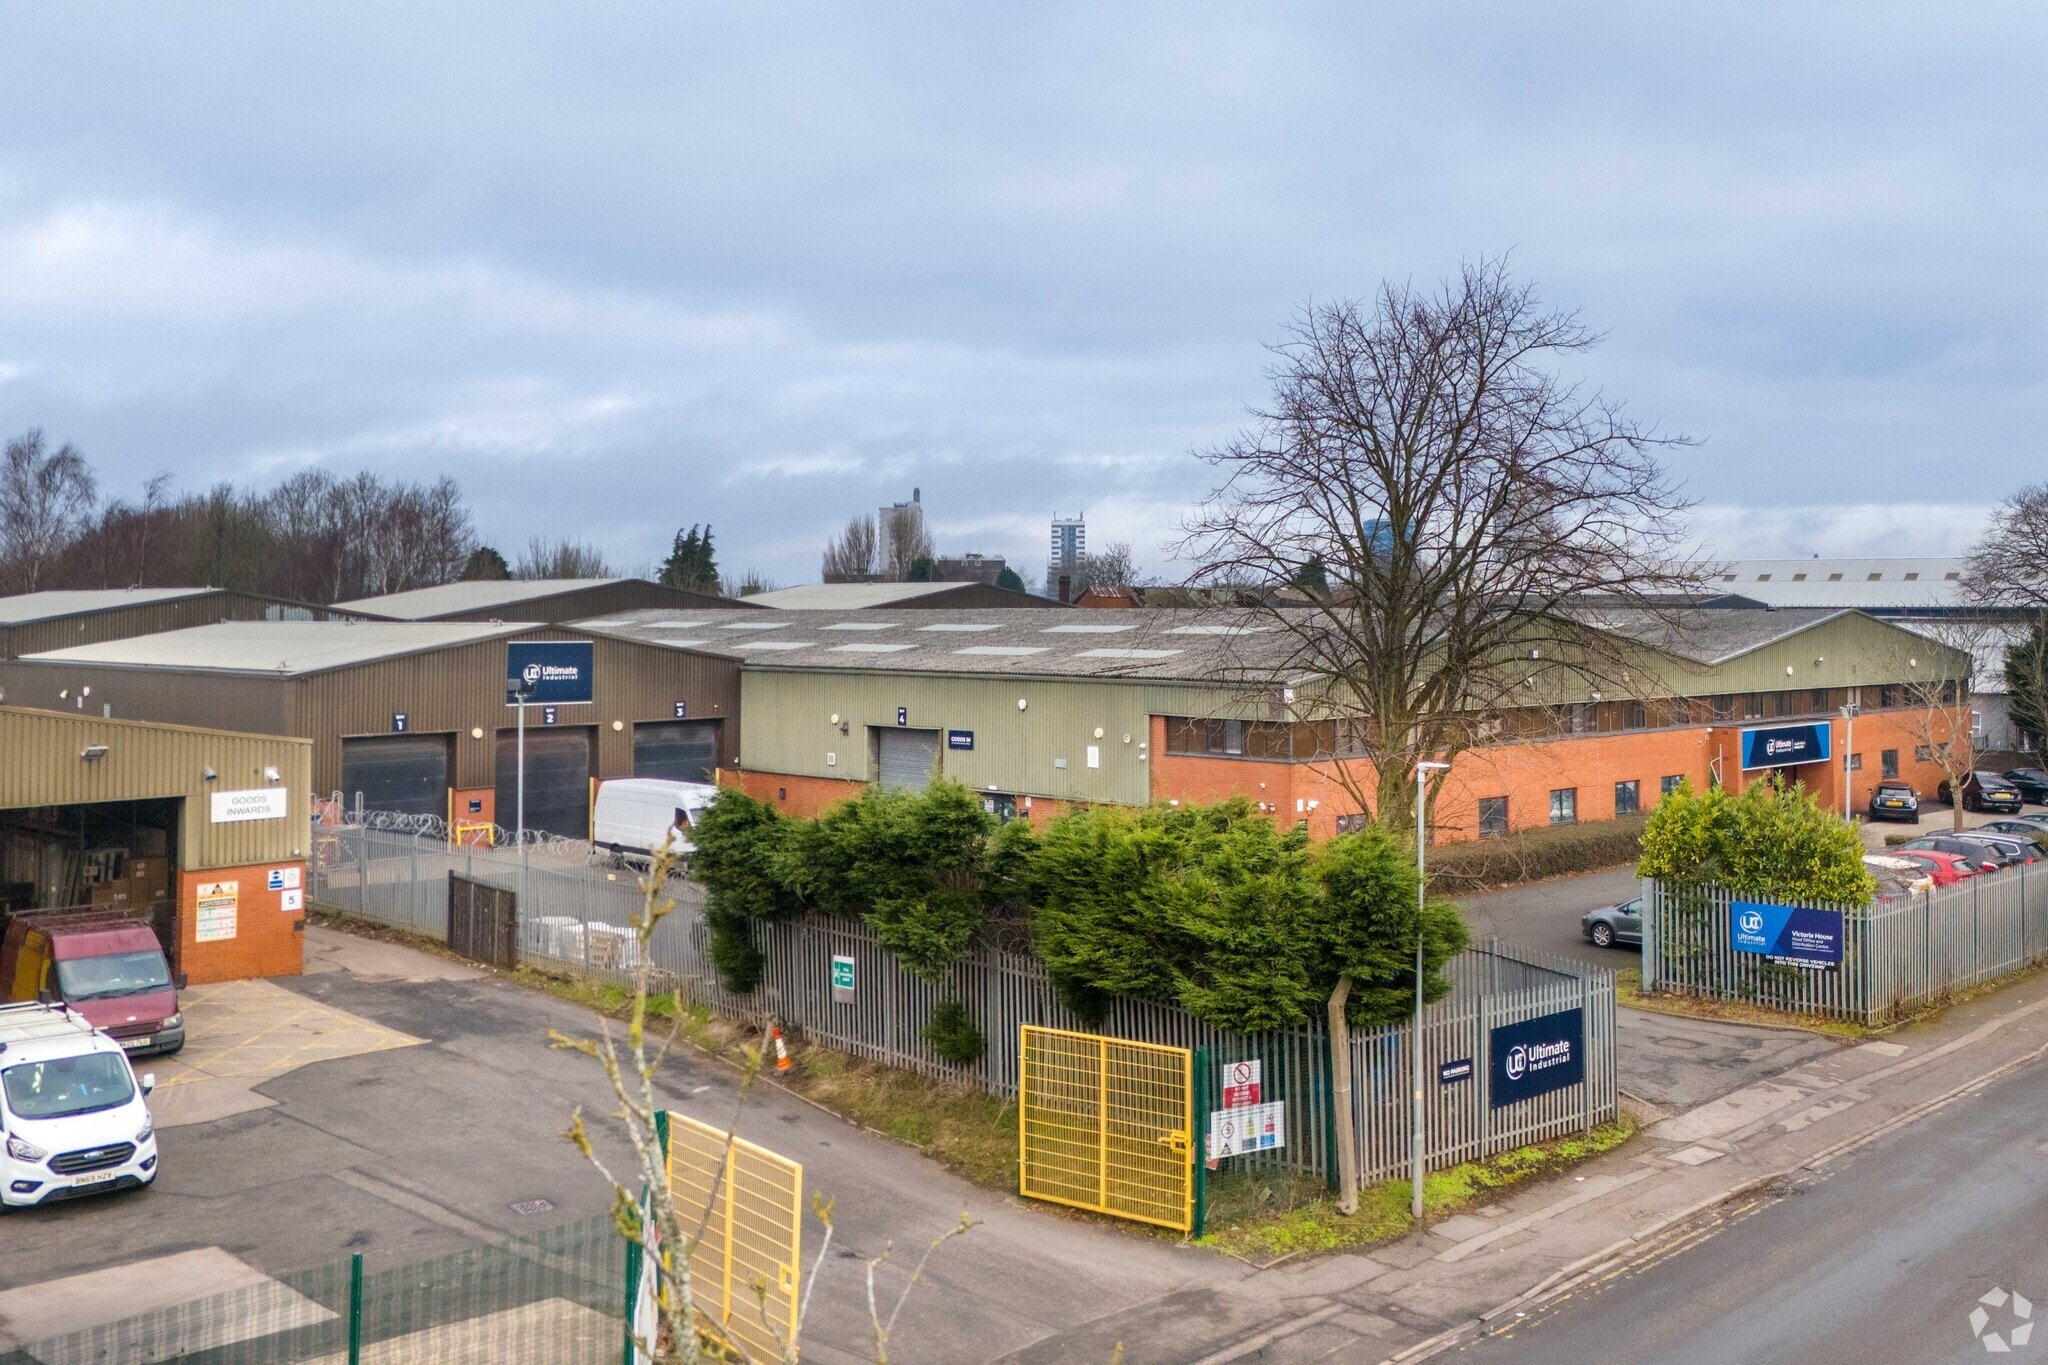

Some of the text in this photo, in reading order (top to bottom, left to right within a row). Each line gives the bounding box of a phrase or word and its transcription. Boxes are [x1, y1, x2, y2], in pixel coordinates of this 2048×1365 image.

[542, 666, 578, 675] Ultimate
[676, 707, 683, 717] 3
[546, 714, 554, 723] 2
[899, 715, 905, 723] 4
[397, 721, 403, 730] 1
[231, 795, 267, 805] GOODS
[226, 804, 271, 816] INWARDS
[288, 895, 295, 905] 5
[1737, 933, 1766, 942] Ultimate
[1791, 930, 1814, 939] Victoria
[1785, 956, 1810, 964] REVERSE
[1810, 959, 1835, 967] VEHICLES
[1528, 1040, 1570, 1062] Ultimate
[1529, 1052, 1570, 1072] Industrial
[1442, 1069, 1451, 1077] NO
[1450, 1064, 1470, 1074] PARKING
